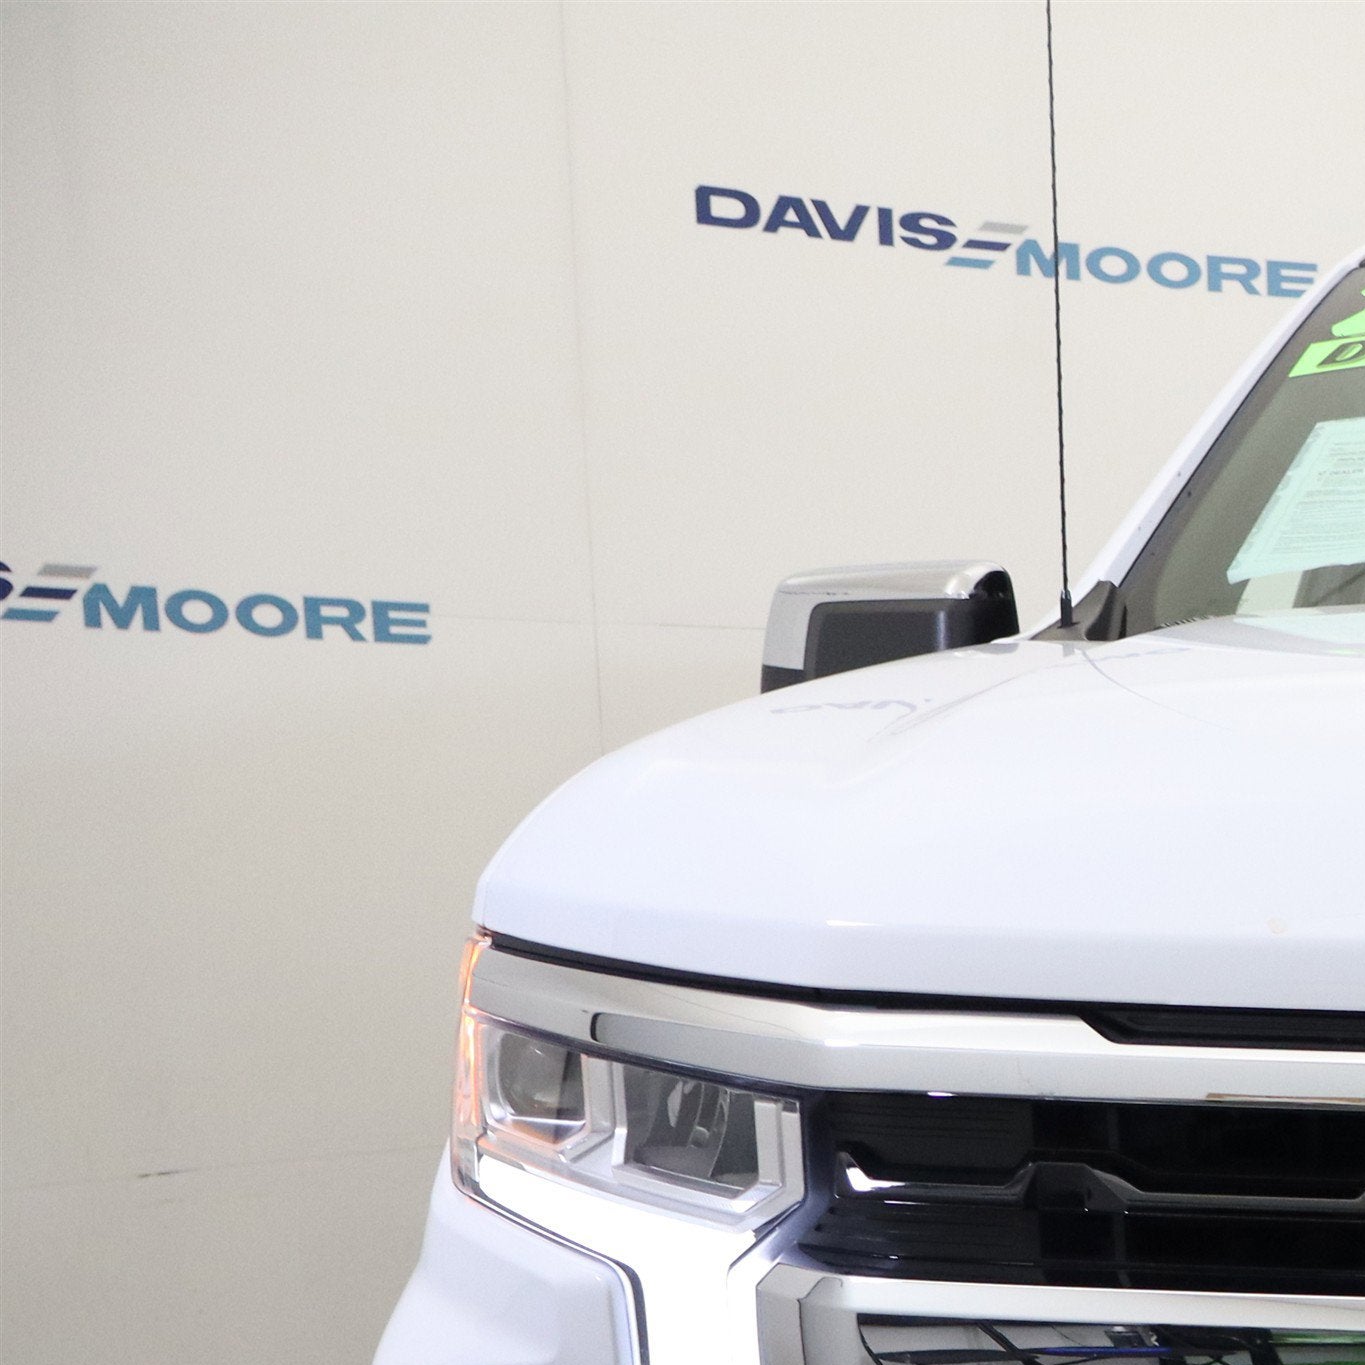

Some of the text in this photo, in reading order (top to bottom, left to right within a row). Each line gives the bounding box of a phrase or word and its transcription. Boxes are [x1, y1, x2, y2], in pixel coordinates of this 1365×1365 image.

[695, 185, 1318, 299] DAVIS MOORE
[83, 583, 432, 645] MOORE
